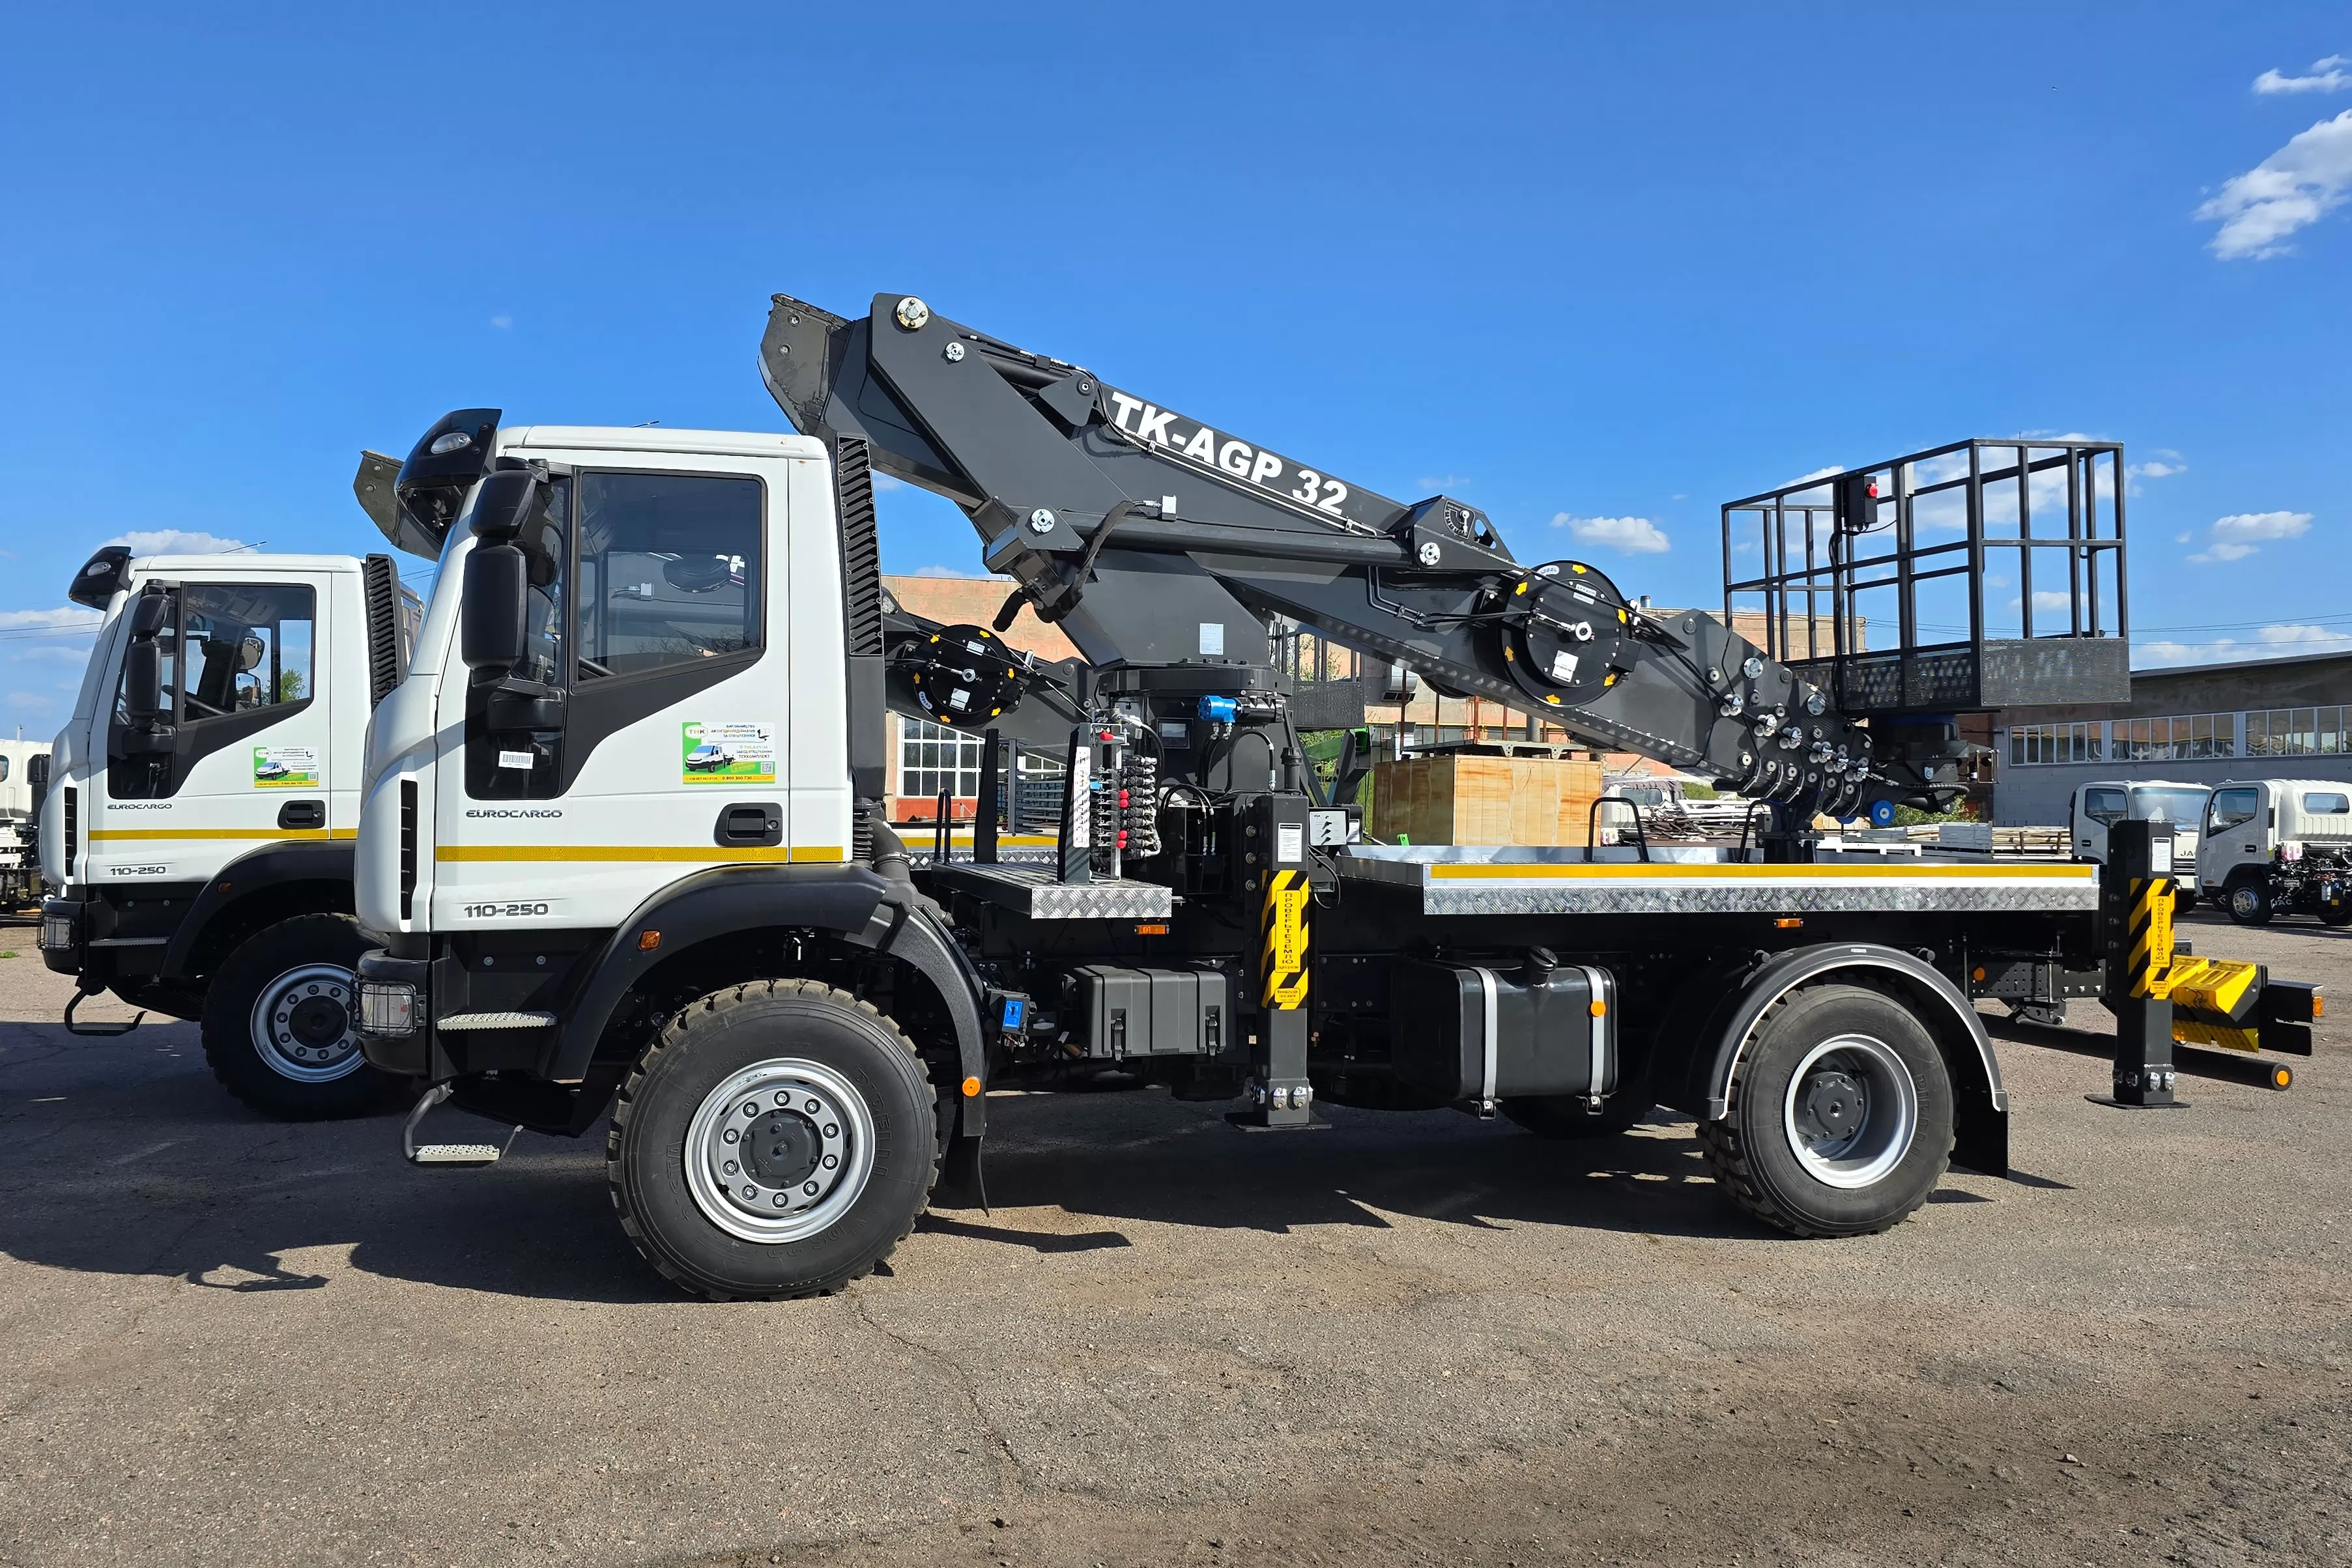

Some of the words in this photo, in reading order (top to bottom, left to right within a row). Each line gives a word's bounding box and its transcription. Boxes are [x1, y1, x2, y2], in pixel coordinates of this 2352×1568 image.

[1111, 391, 1283, 484] TK-AGP
[1293, 470, 1348, 515] 32
[466, 809, 563, 818] EUROCARGO
[110, 866, 166, 876] 110-250
[464, 903, 549, 918] 110-250
[852, 1066, 892, 1176] PIRELLI
[1902, 1072, 1930, 1170] PIRELLI
